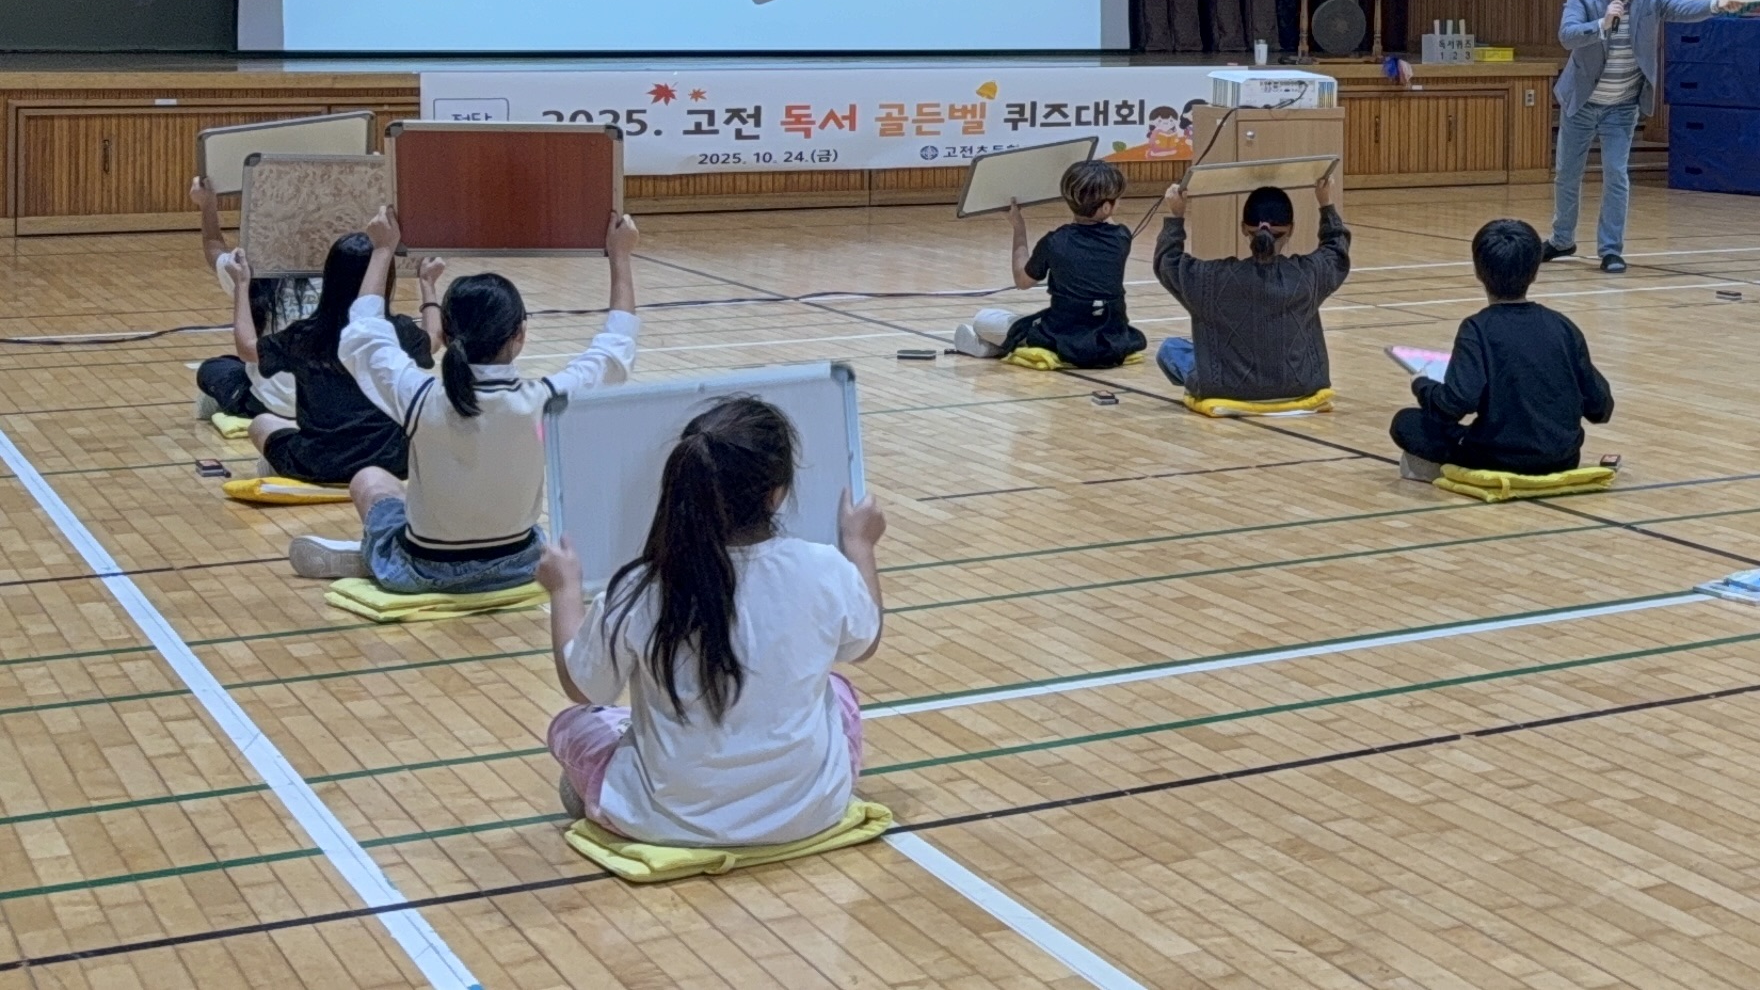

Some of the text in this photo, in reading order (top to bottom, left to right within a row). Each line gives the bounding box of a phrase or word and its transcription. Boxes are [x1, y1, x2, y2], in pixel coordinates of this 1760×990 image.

[1465, 51, 1471, 60] 3
[682, 105, 762, 140] 고전
[780, 104, 857, 138] 독서
[875, 101, 987, 137] 골든벨
[1003, 99, 1146, 131] 퀴즈대회
[698, 148, 839, 165] 2025. 10. 24.(금)
